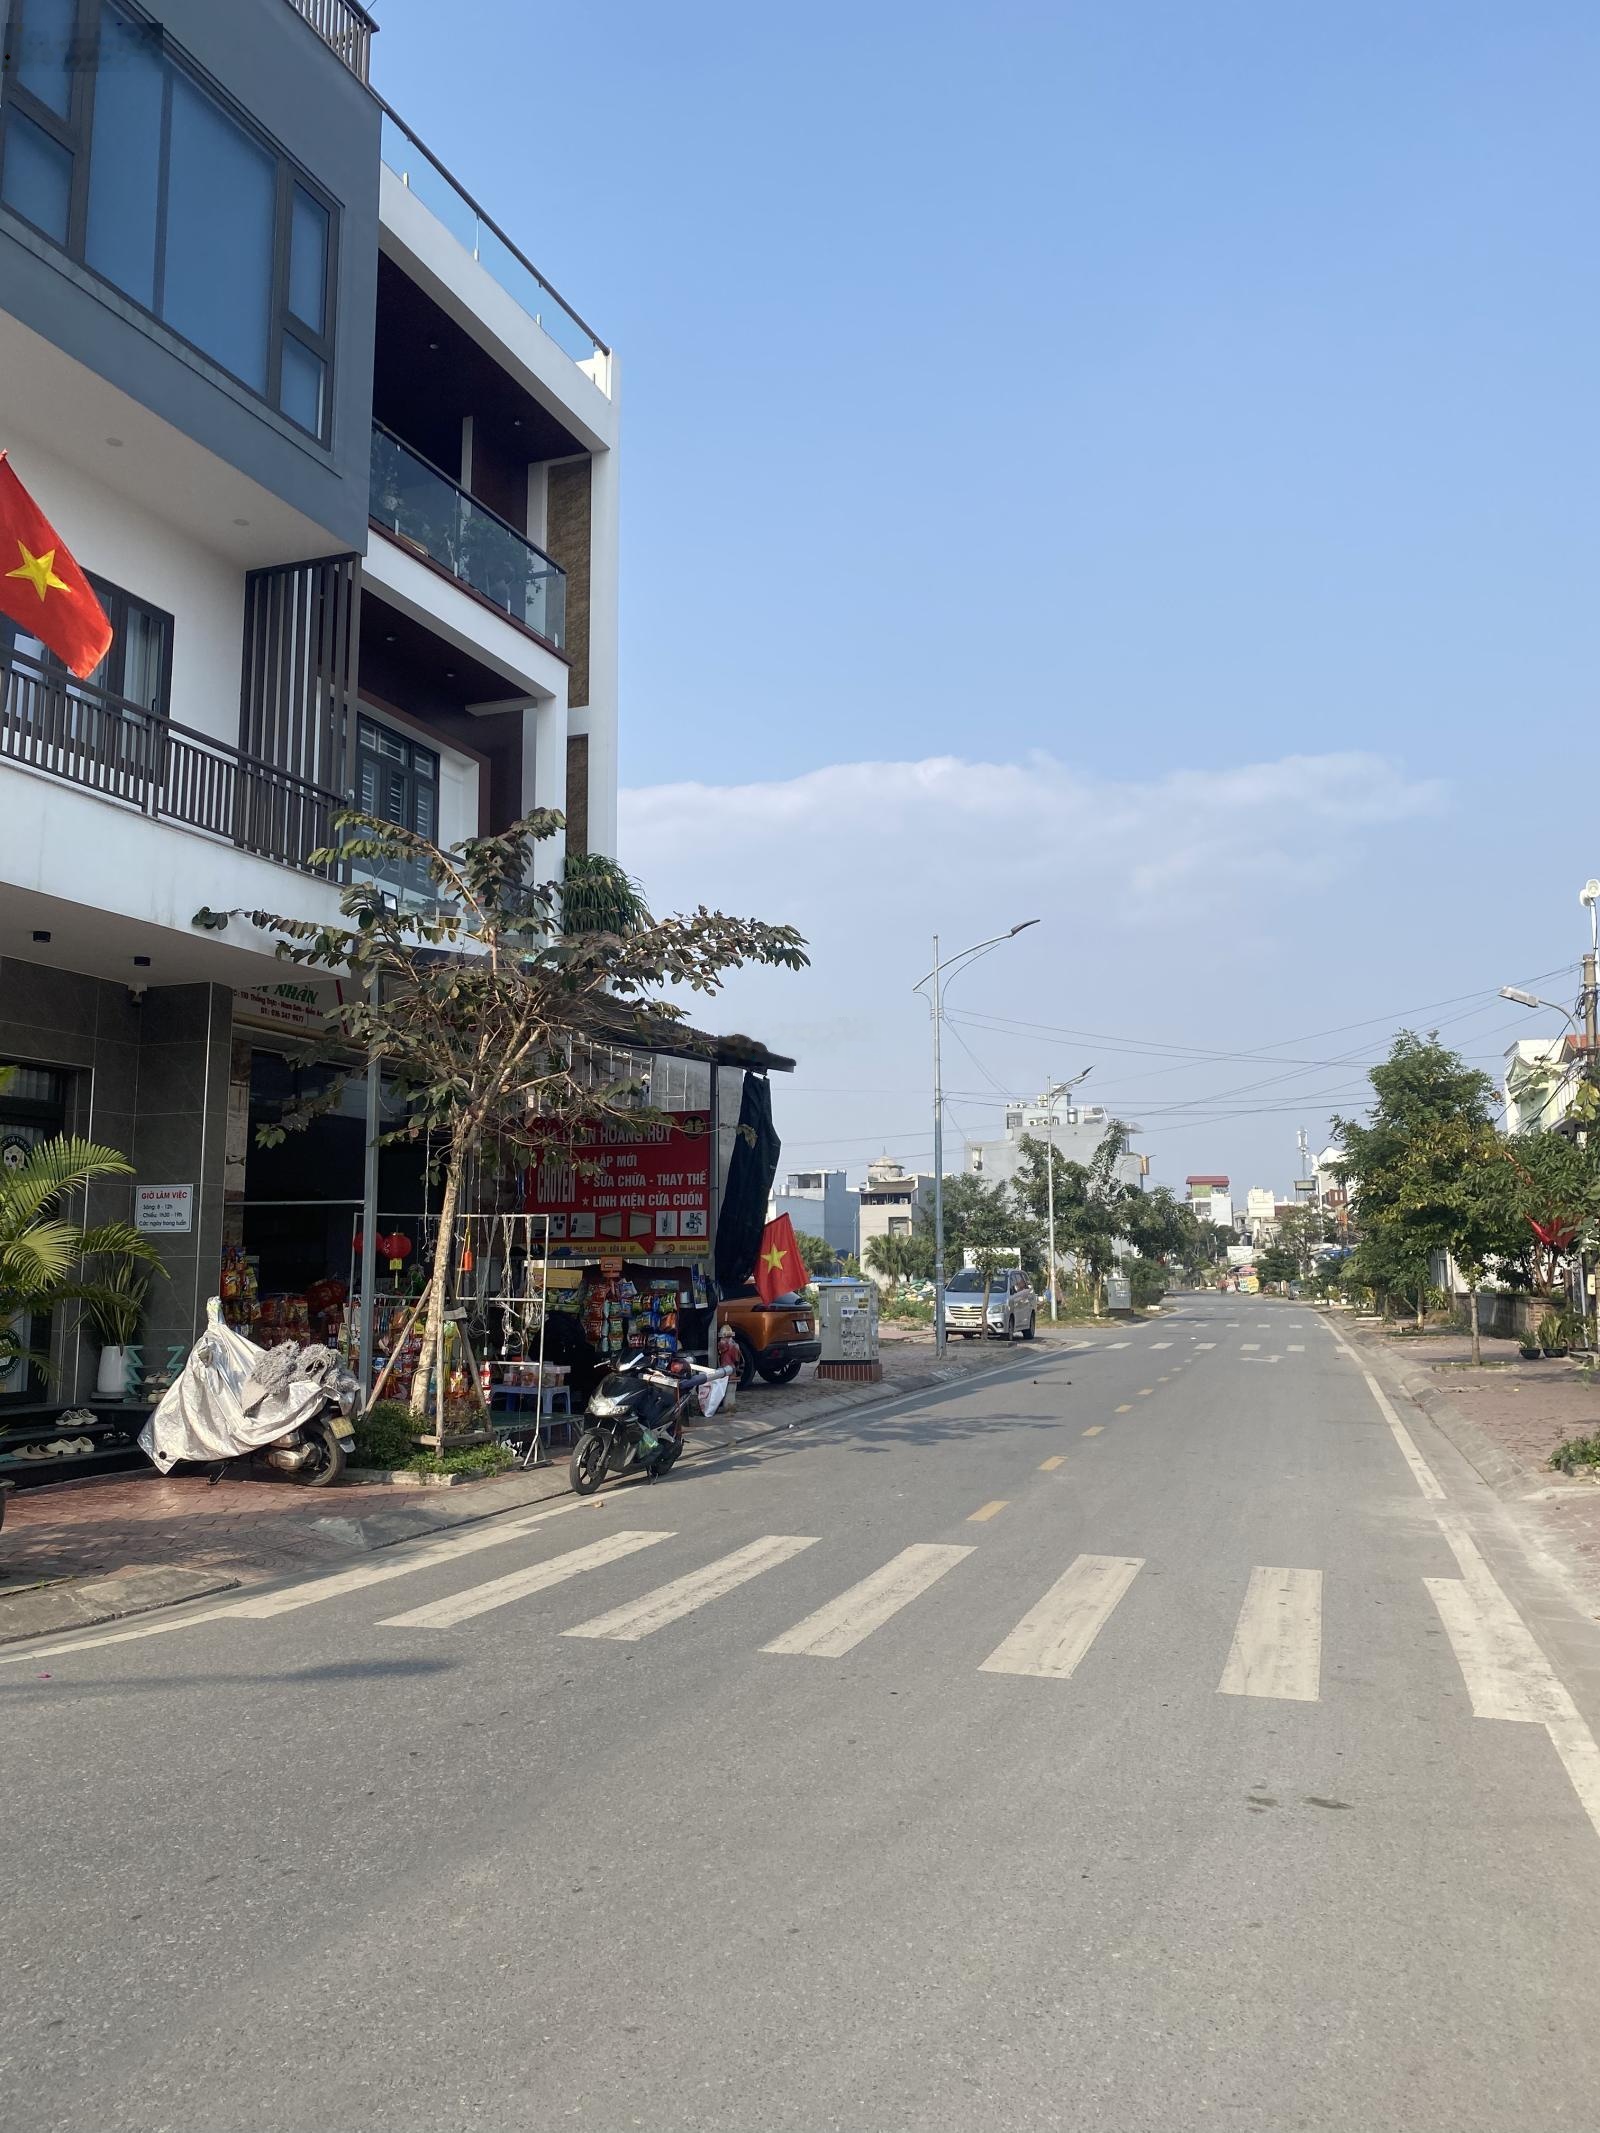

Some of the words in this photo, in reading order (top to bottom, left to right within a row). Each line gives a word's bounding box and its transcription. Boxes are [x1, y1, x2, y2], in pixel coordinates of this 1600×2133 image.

[616, 1153, 637, 1168] MỚI
[656, 1173, 684, 1187] THAY
[687, 1169, 707, 1186] THẾ
[593, 1195, 617, 1208] LINH
[619, 1193, 645, 1210] KIỆN
[648, 1190, 670, 1207] CỬA
[672, 1189, 703, 1206] CUỐN
